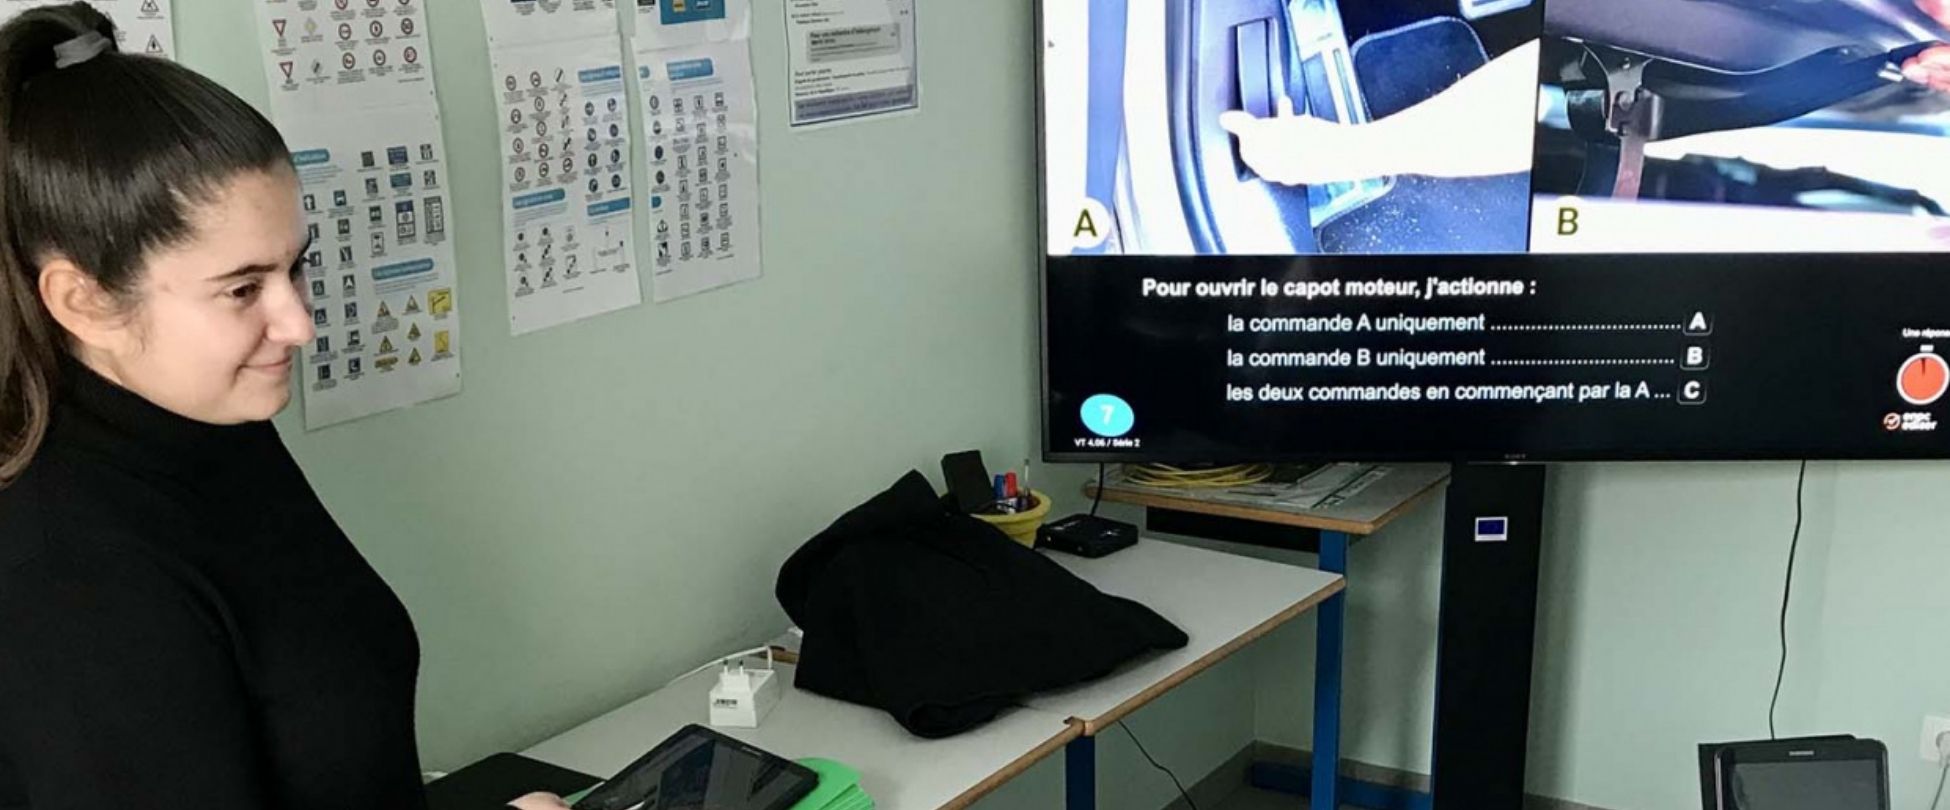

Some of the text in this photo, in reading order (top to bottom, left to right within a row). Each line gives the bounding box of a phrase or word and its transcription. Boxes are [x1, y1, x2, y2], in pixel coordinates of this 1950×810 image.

[1074, 209, 1097, 237] A
[1558, 207, 1578, 235] B
[1142, 278, 1191, 297] Pour
[1195, 278, 1256, 297] ouvrir
[1260, 278, 1279, 297] le
[1283, 279, 1340, 300] capot
[1345, 279, 1421, 299] moteur,
[1424, 277, 1525, 300] j'actionne
[1227, 311, 1707, 335] la commande A uniquement A
[1226, 346, 1703, 369] la commande B uniquement B
[1226, 383, 1253, 401] les
[1257, 383, 1304, 401] deux
[1307, 382, 1422, 401] commandes
[1425, 385, 1450, 401] en
[1454, 382, 1575, 403] commençant
[1578, 384, 1611, 403] par
[1614, 381, 1632, 399] la
[1635, 380, 1651, 399] A
[1683, 380, 1701, 399] C
[1101, 404, 1115, 425] 7
[1074, 438, 1087, 447] VT
[1134, 438, 1141, 447] 2
